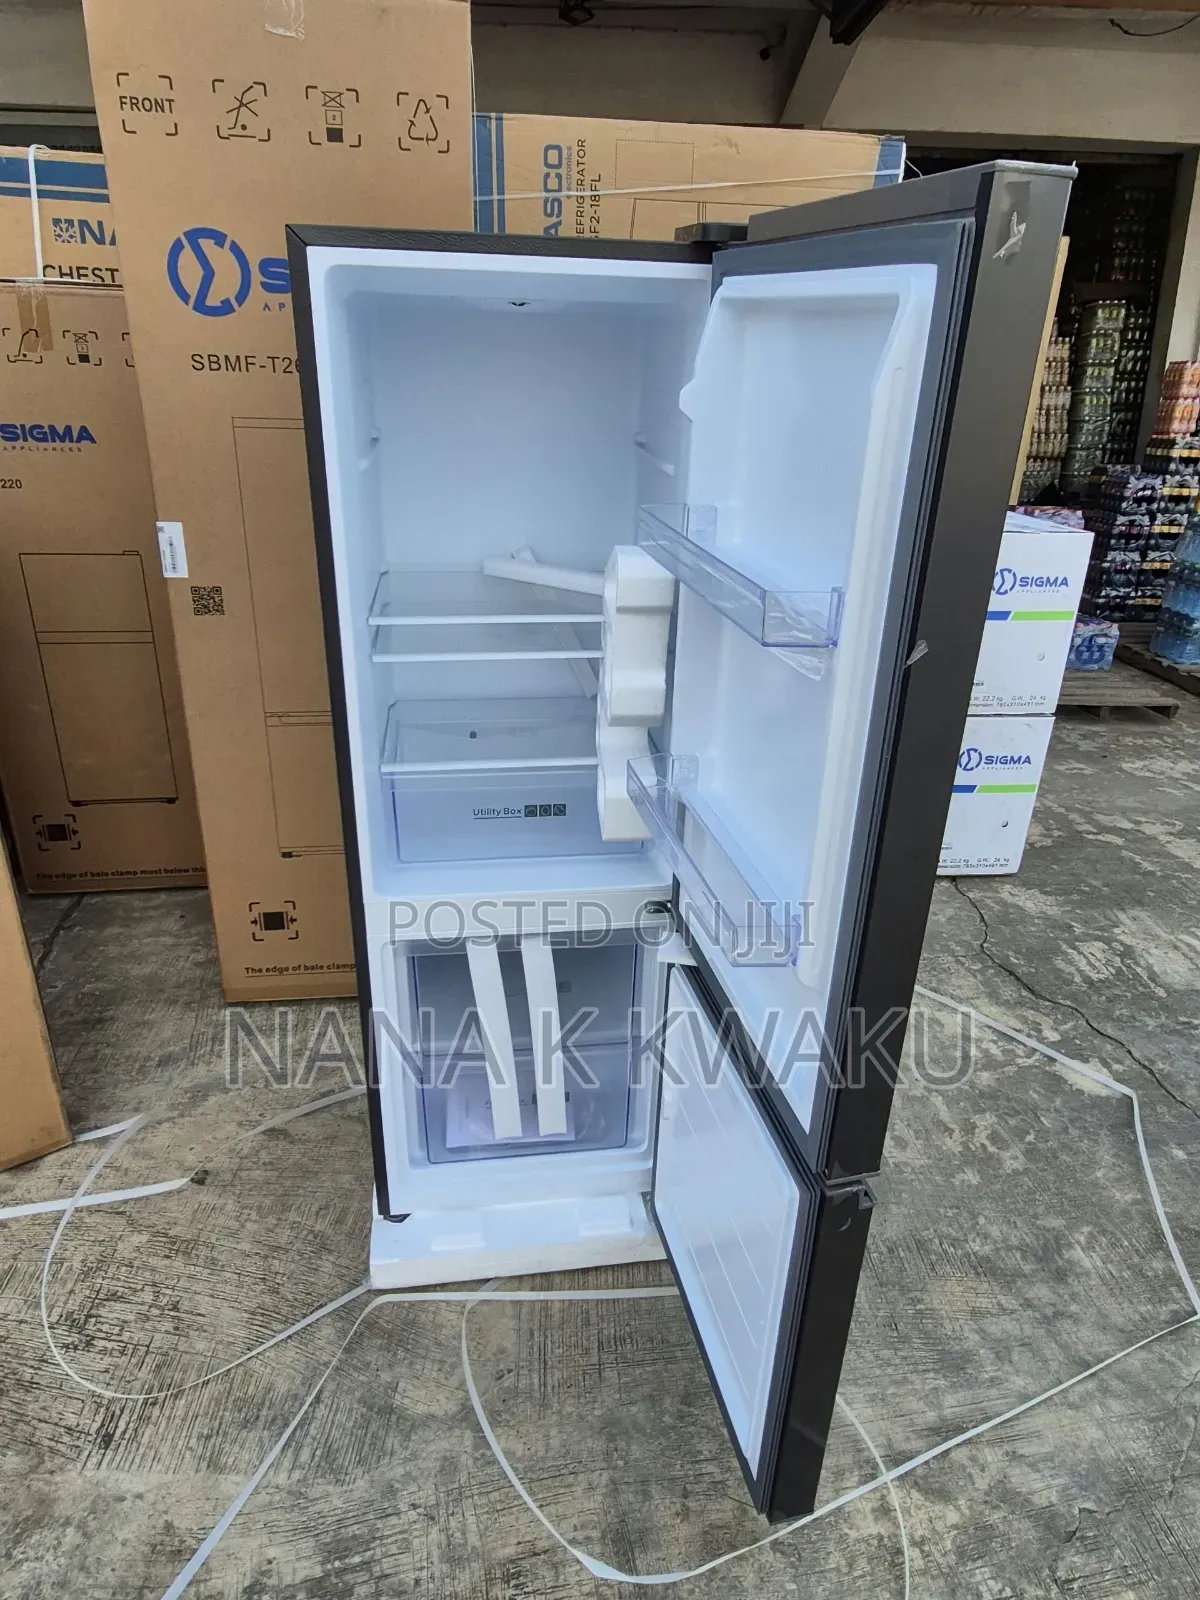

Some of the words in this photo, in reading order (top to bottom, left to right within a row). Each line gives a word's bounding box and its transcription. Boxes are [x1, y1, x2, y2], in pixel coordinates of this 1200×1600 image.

[118, 94, 175, 115] FRONT
[576, 138, 586, 239] EFRIGERATOR
[0, 424, 97, 444] SIGMA
[1018, 576, 1069, 588] SIGMA
[983, 755, 1032, 765] SIGMA
[473, 808, 501, 817] Utility
[503, 807, 522, 815] Box
[79, 871, 88, 879] of
[110, 869, 138, 878] clamp
[163, 866, 190, 874] below
[265, 966, 289, 974] edge
